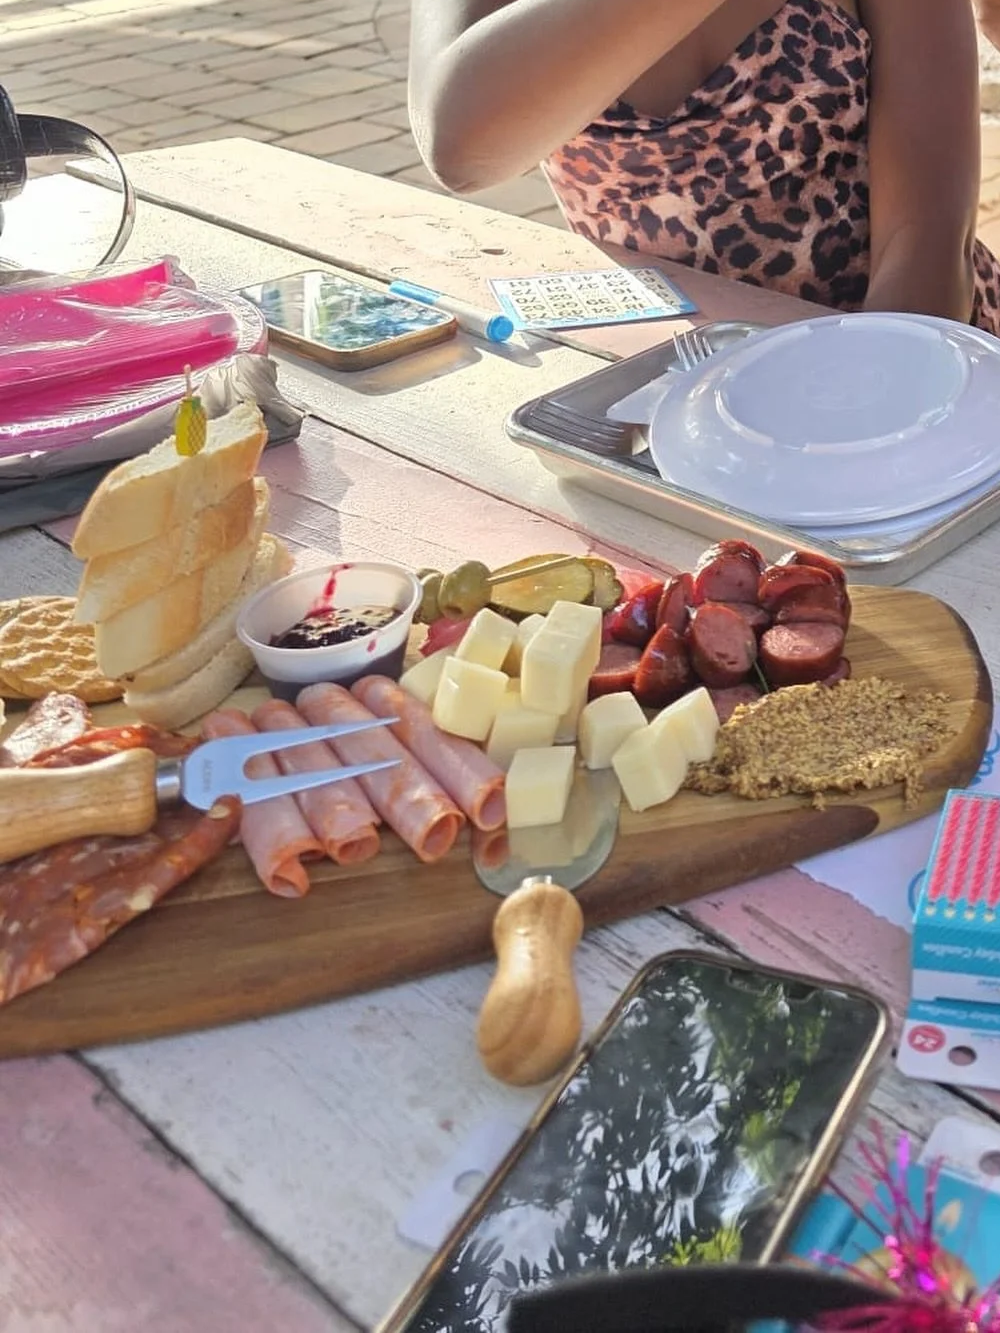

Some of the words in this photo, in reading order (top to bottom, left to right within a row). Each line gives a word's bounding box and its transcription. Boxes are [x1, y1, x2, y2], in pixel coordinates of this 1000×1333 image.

[511, 288, 537, 296] 72
[515, 296, 540, 304] 70
[922, 943, 973, 959] Candles
[913, 1034, 938, 1048] 24
